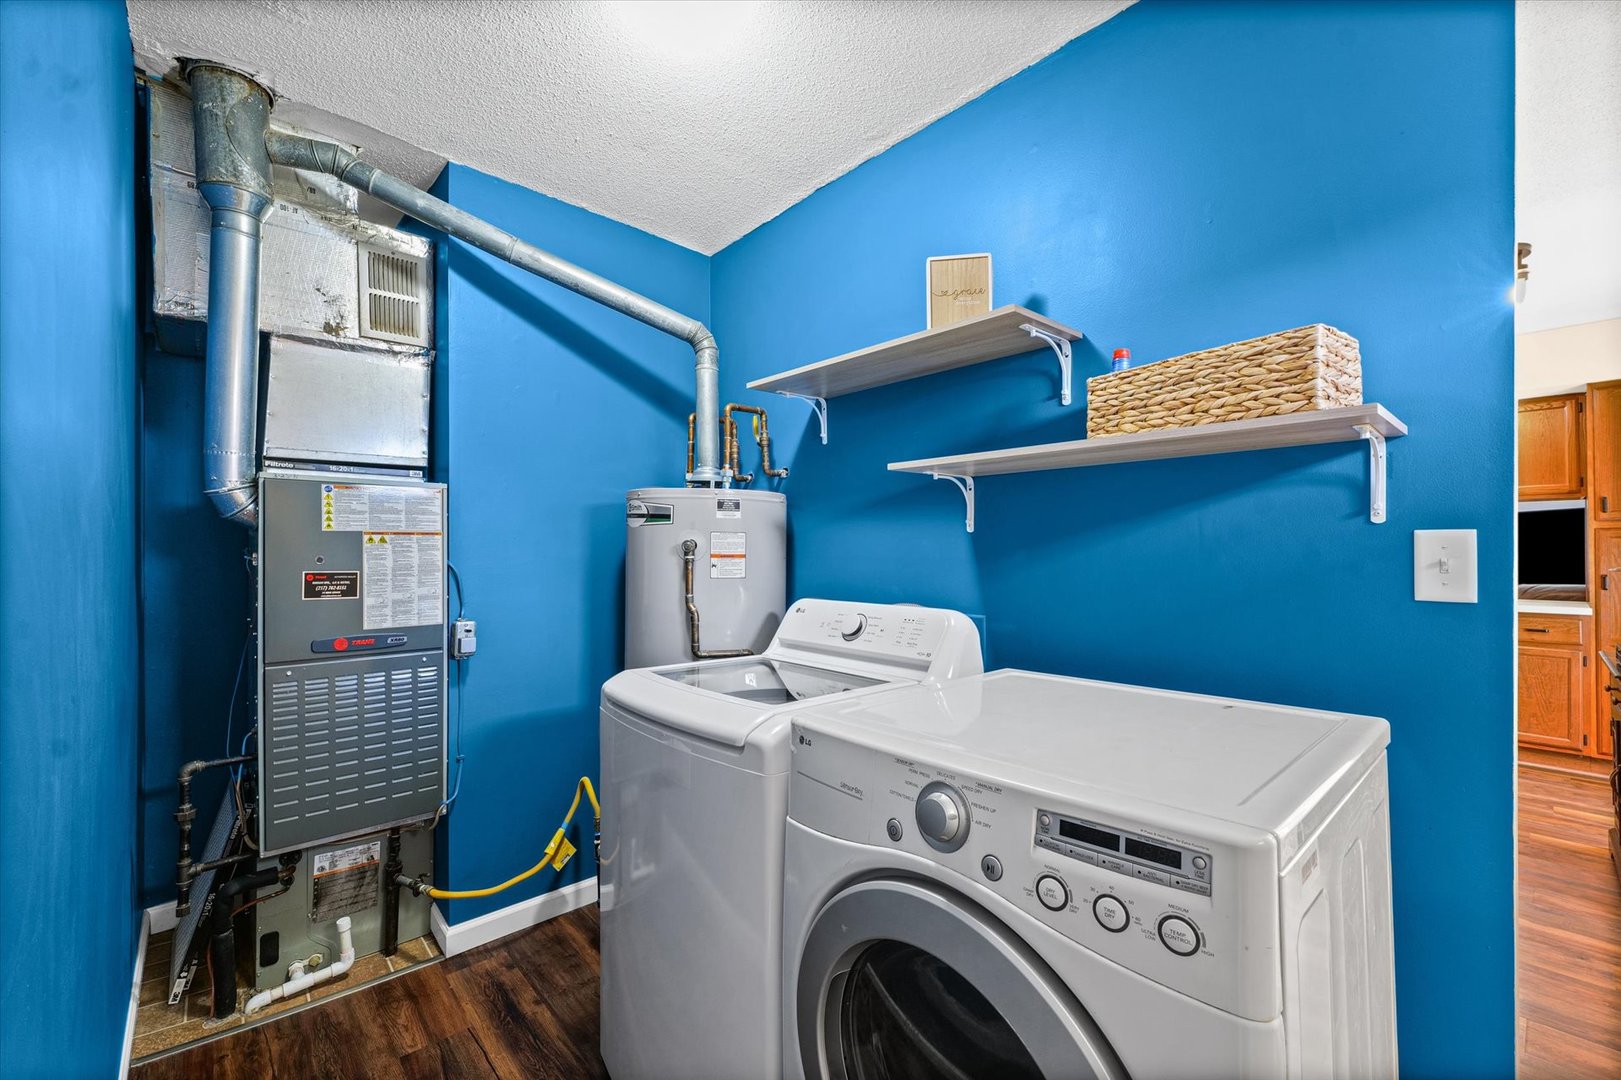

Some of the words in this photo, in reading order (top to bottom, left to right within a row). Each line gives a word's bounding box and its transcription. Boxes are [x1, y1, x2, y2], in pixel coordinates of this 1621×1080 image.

[265, 460, 294, 469] Filtrete
[805, 738, 811, 746] LG
[1043, 891, 1057, 900] LEVEL
[1104, 906, 1115, 914] TIME
[1168, 903, 1189, 913] MEDIUM
[1141, 928, 1155, 936] ULTRA
[1163, 932, 1192, 947] CONTROL
